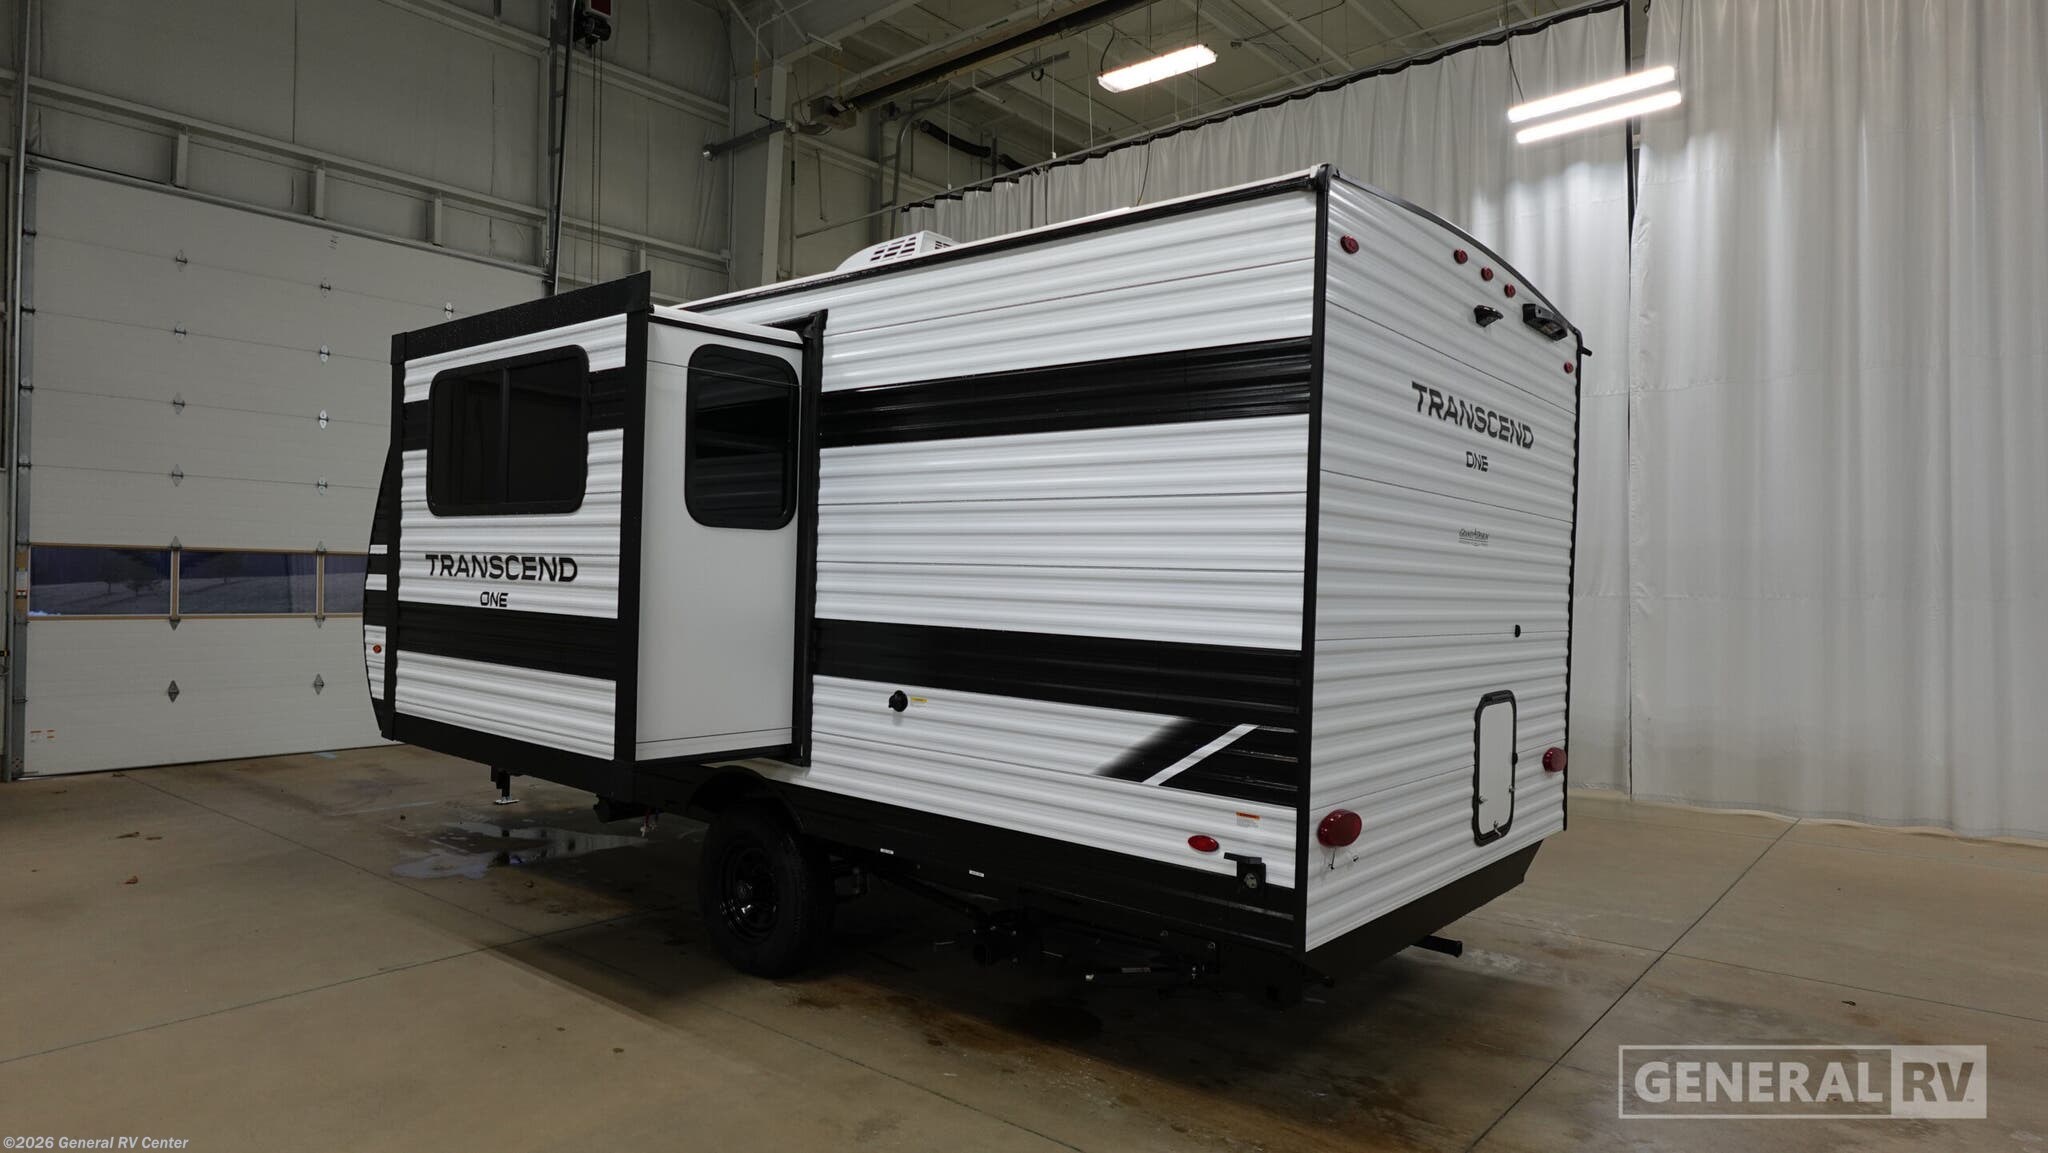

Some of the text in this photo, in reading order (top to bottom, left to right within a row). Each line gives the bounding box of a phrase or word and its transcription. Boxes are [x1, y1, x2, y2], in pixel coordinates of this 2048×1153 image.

[1411, 380, 1535, 450] TRANSCEND
[425, 553, 578, 583] TRANSCEND
[479, 591, 509, 609] ONE
